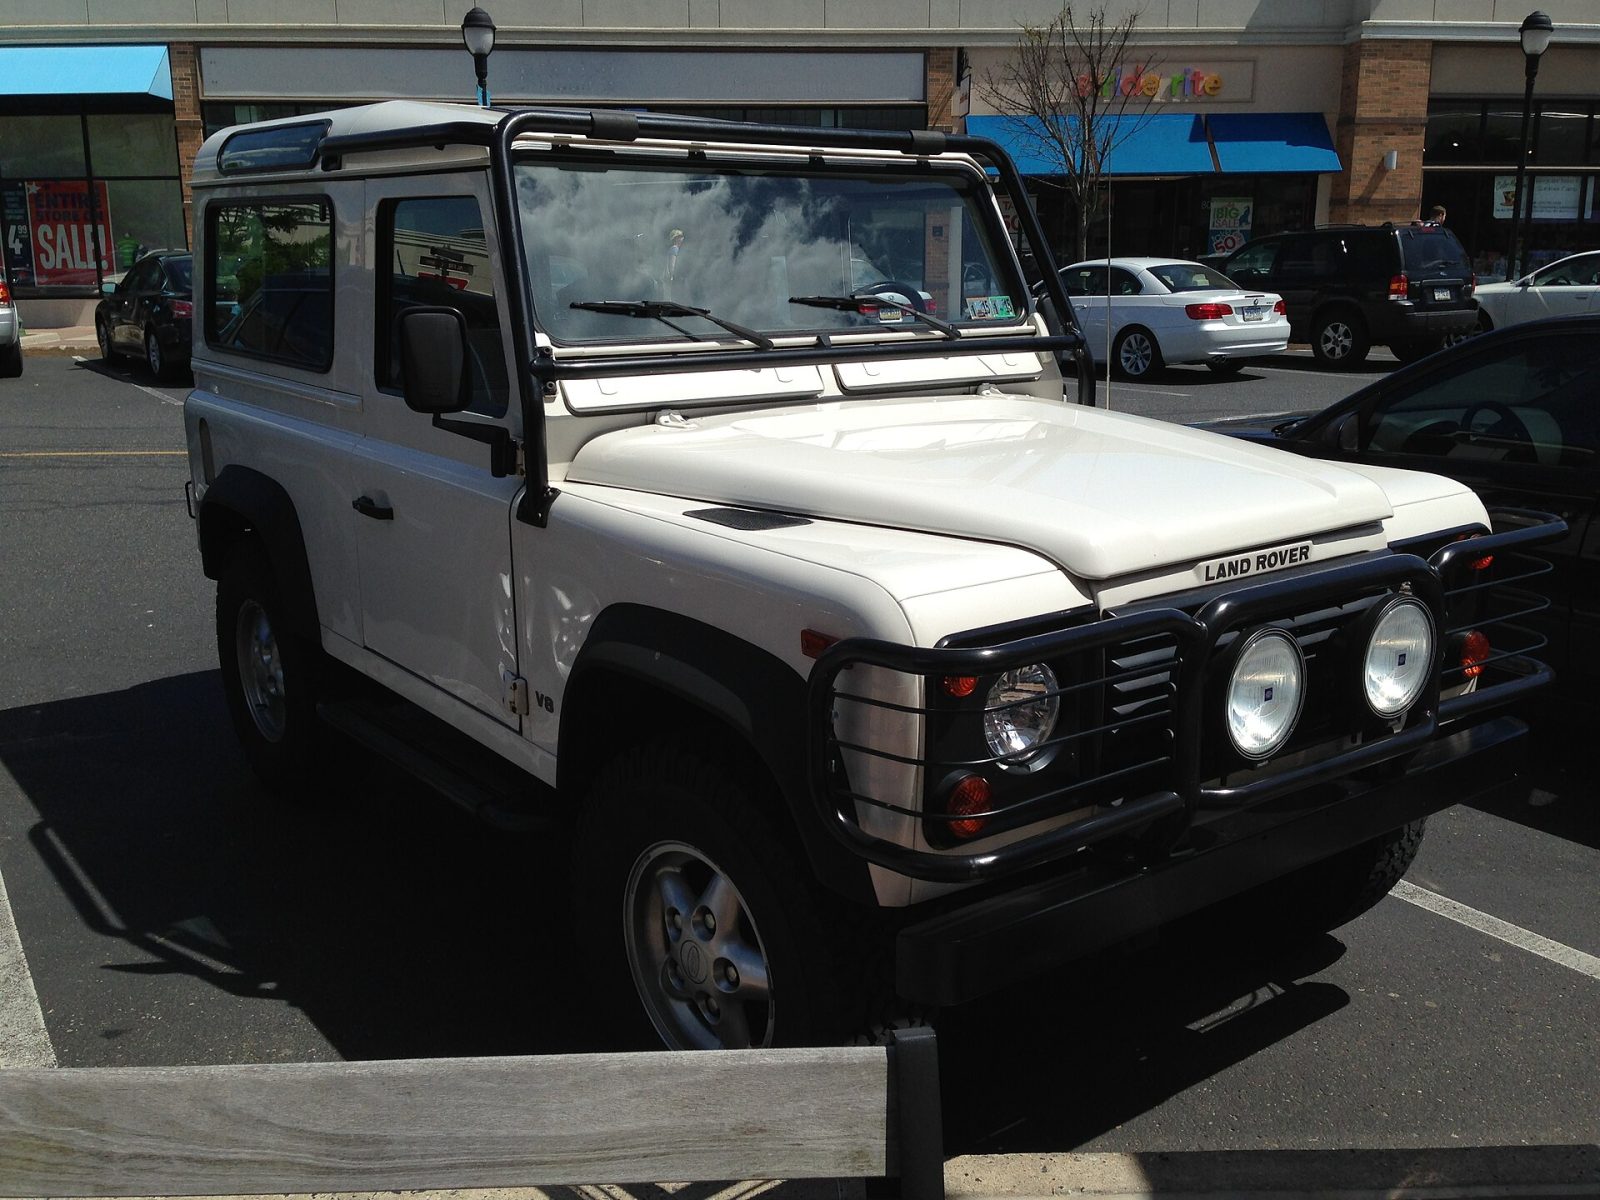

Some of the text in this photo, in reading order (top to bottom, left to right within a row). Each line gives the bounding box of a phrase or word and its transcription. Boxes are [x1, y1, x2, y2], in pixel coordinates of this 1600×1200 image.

[1171, 67, 1223, 97] rite
[35, 192, 101, 209] ENTIRE
[36, 209, 80, 222] STORE
[1216, 207, 1240, 219] BIG
[37, 223, 109, 270] SALE!
[1204, 545, 1310, 581] LAND ROVER
[535, 690, 554, 713] V8
